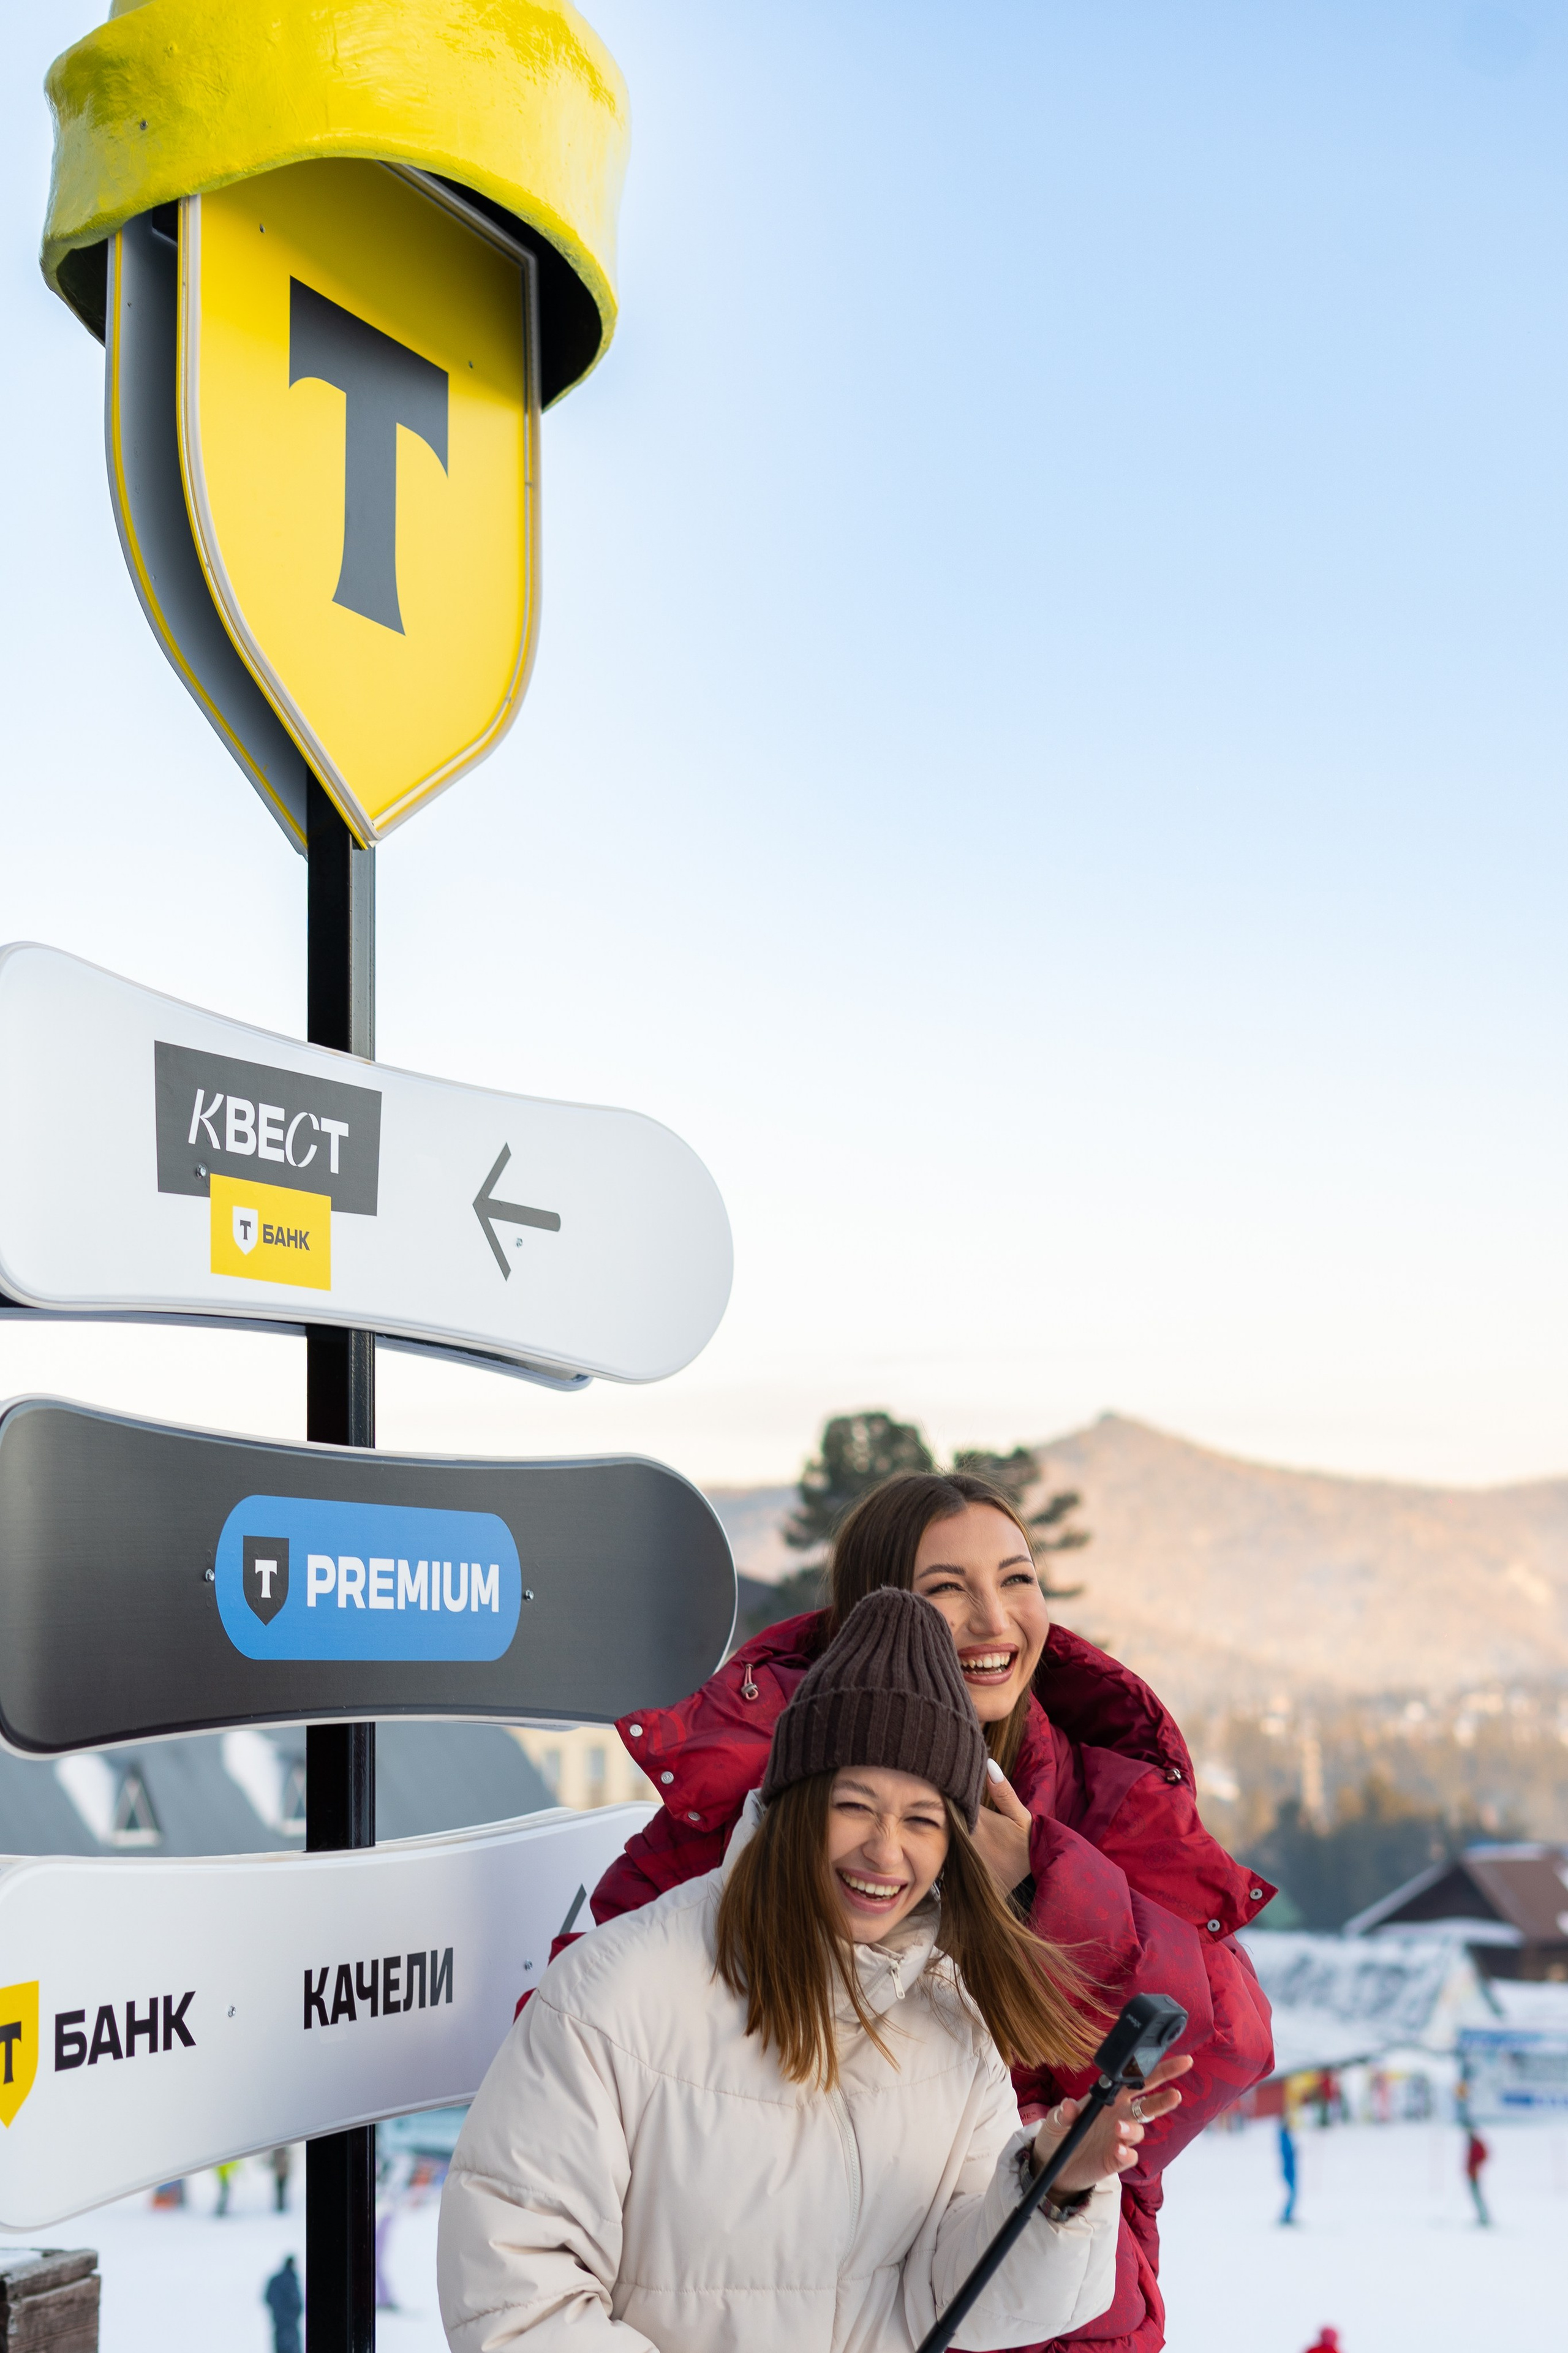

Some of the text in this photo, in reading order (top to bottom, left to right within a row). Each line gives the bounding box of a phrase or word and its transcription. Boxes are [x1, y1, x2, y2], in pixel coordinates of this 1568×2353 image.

[289, 275, 449, 636] Т
[188, 1088, 349, 1174] КВЕСТ
[239, 1220, 311, 1251] Т БАНК
[255, 1554, 499, 1613] T PREMIUM
[303, 1947, 454, 2030] КАЧЕЛИ
[55, 1991, 197, 2072] БАНК
